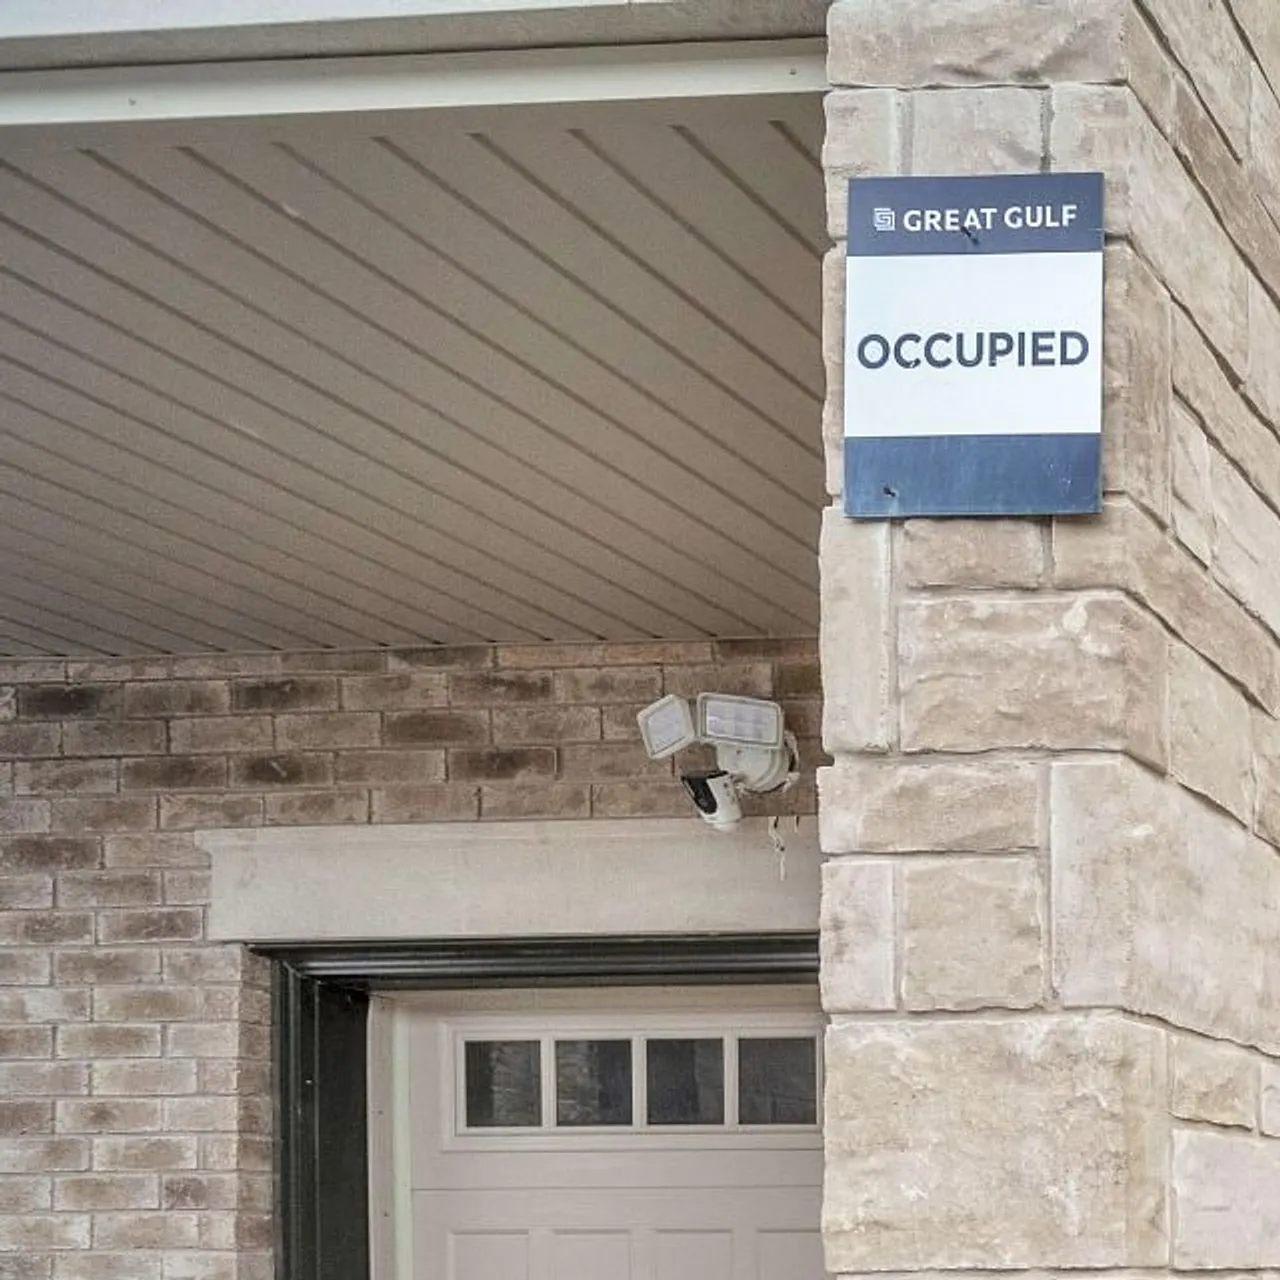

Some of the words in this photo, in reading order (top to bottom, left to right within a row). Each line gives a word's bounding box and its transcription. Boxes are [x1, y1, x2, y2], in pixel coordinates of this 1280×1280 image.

[903, 208, 998, 231] GREAT
[1004, 205, 1077, 229] GULF
[857, 331, 1090, 369] OCCUPIED
